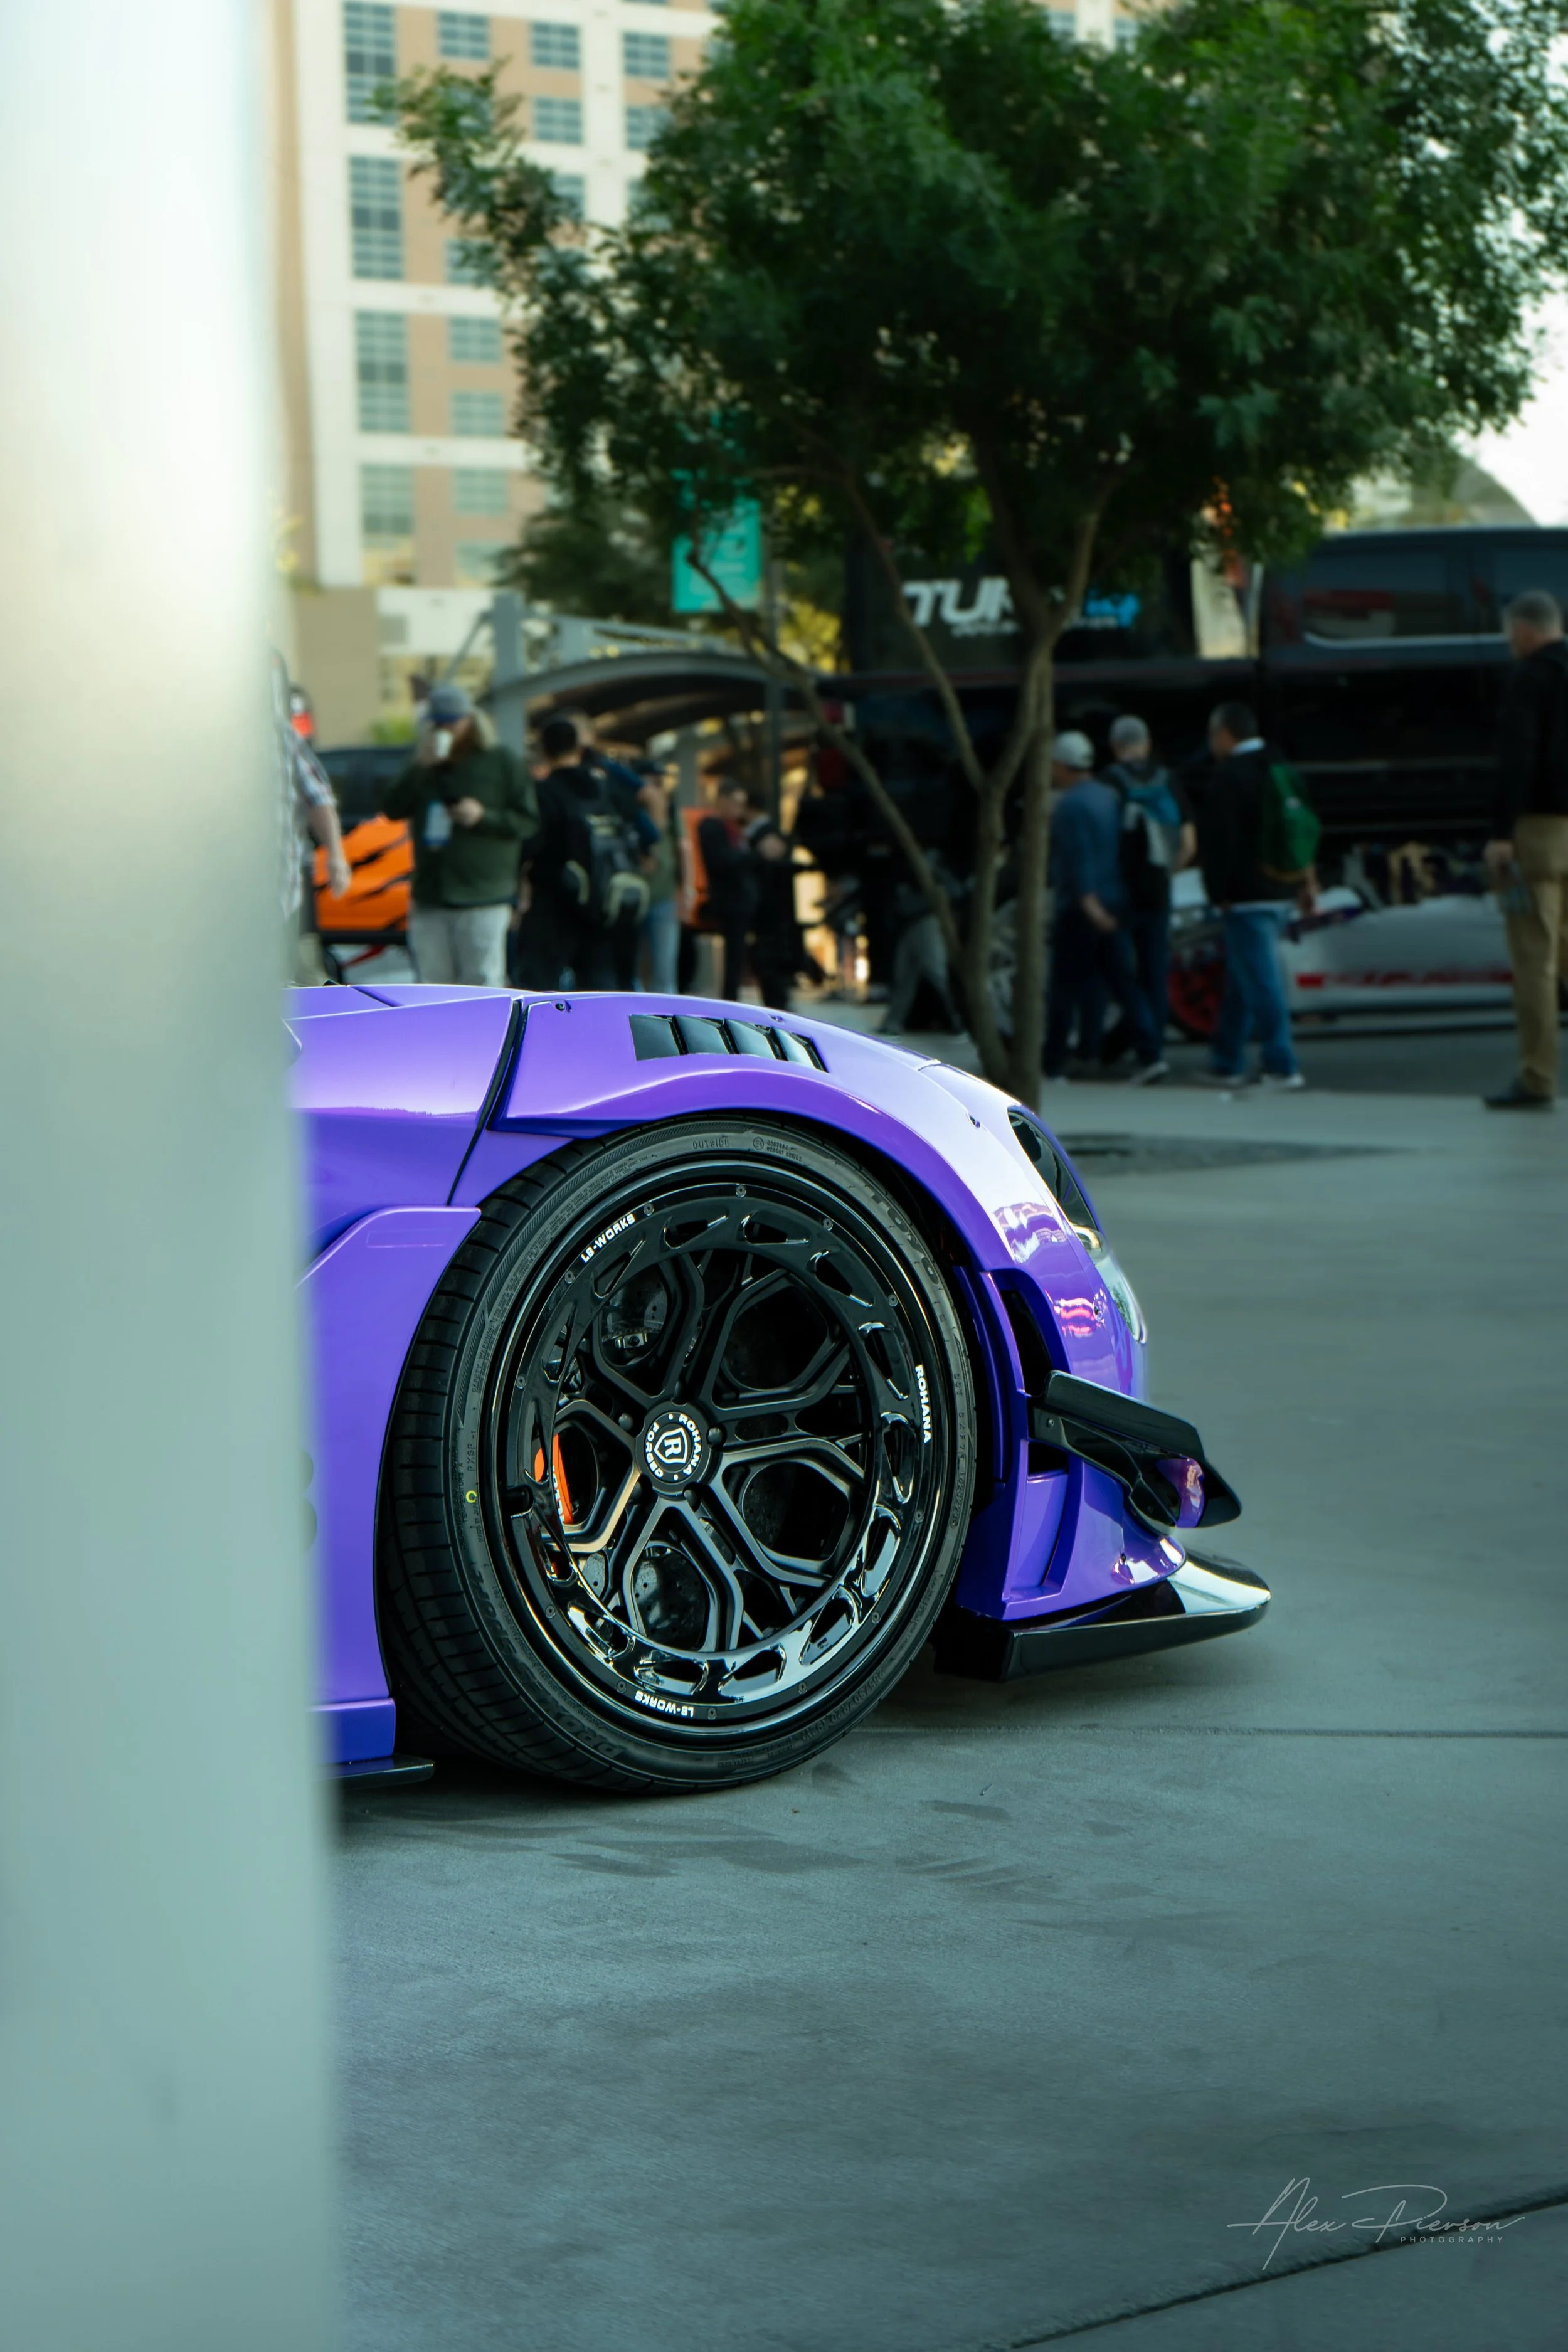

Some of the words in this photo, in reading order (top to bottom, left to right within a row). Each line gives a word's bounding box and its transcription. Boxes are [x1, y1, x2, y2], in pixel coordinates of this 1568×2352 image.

[692, 1137, 730, 1150] OUTSIDE
[580, 1213, 636, 1263] LB-WORKS
[915, 1364, 932, 1444] ROHANA
[645, 1422, 664, 1478] FORGED
[664, 1436, 682, 1458] R
[679, 1413, 702, 1476] ROHANA
[634, 1690, 695, 1718] LB-WORKS
